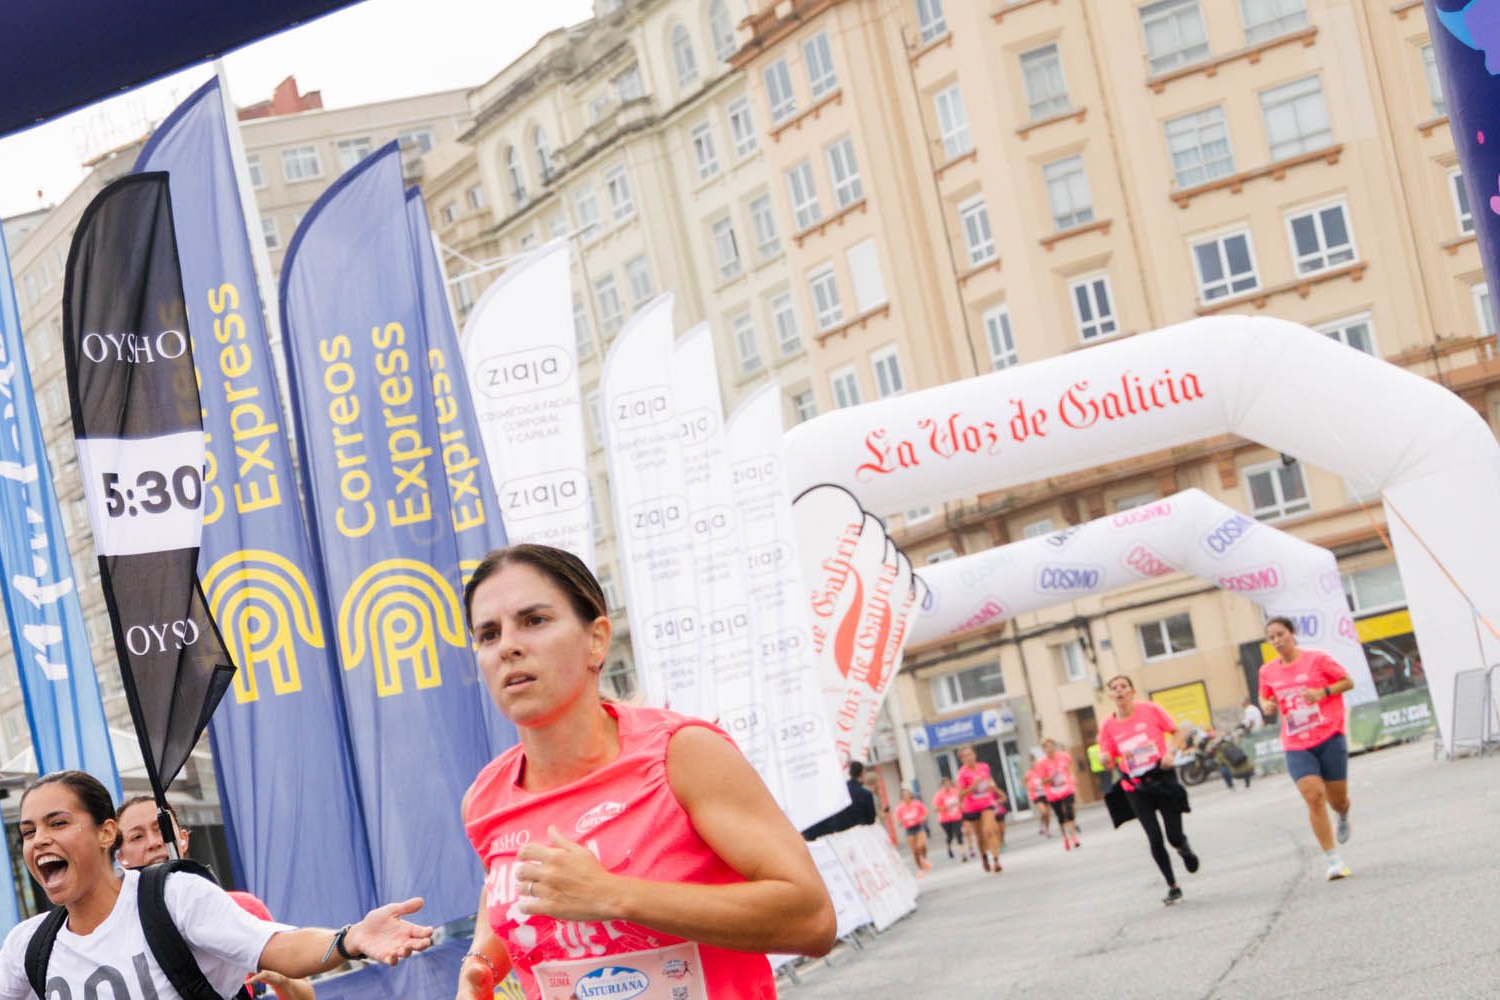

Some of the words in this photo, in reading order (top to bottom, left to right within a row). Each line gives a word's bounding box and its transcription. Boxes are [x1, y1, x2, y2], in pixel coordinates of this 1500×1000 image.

[83, 329, 187, 364] OYSHO
[486, 357, 559, 386] ziaja
[208, 283, 282, 515] Express
[319, 335, 376, 538] Correos
[372, 322, 432, 526] Express
[856, 428, 920, 483] La
[917, 411, 999, 458] Voz
[1008, 398, 1048, 442] de
[1058, 369, 1205, 429] Galicia
[508, 480, 577, 508] ziaja
[1041, 567, 1099, 589] COSMO
[580, 979, 645, 999] ASTURIANA
